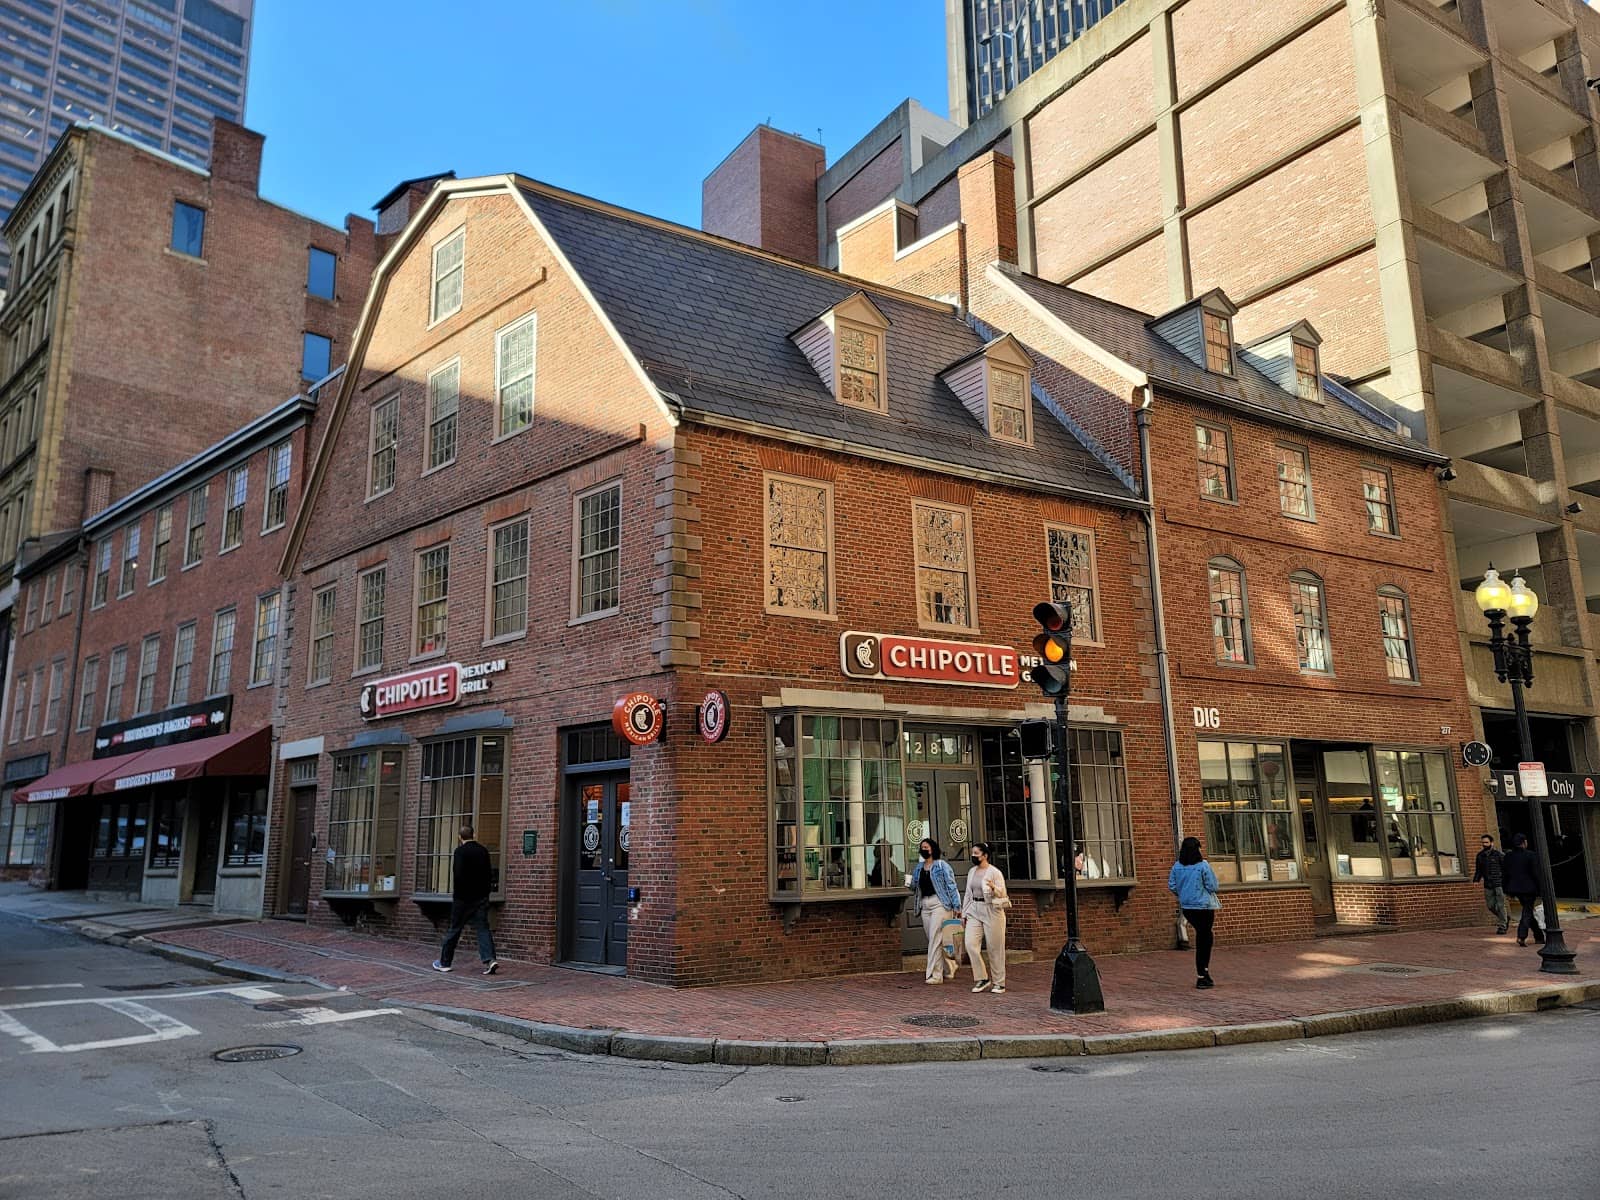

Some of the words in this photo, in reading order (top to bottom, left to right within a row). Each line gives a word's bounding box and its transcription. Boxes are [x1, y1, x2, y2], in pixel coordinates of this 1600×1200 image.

[460, 659, 507, 679] MEXICAN
[890, 645, 1015, 676] CHIPOTLE
[1020, 655, 1078, 671] MEXN
[376, 673, 449, 707] CHIPOTLE
[460, 678, 489, 694] GRILL
[624, 695, 661, 715] CHIPOTLE
[1193, 706, 1220, 729] DIG
[1551, 779, 1575, 799] Only
